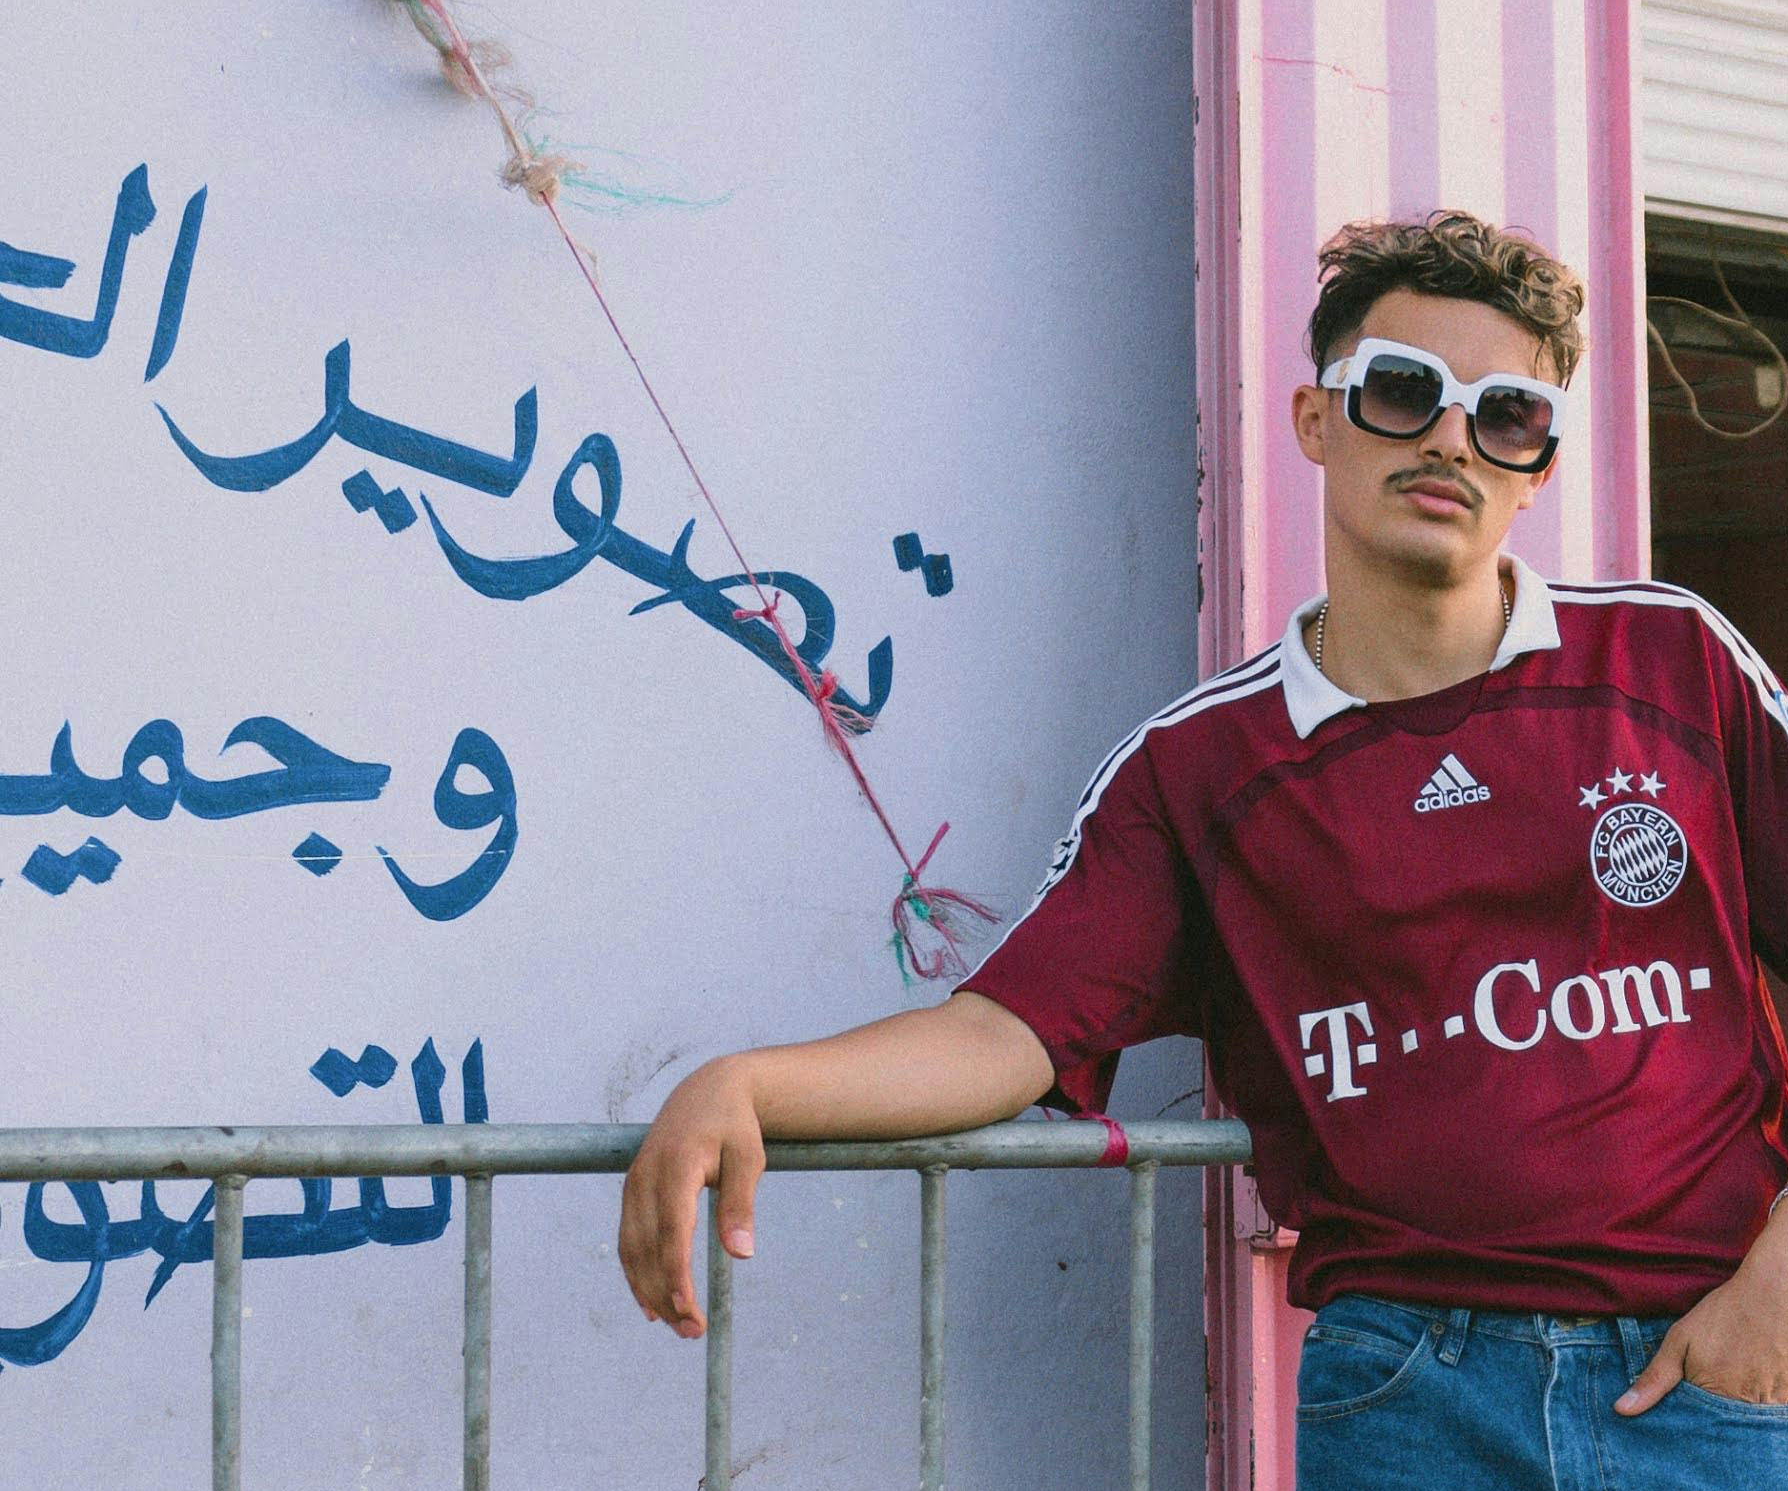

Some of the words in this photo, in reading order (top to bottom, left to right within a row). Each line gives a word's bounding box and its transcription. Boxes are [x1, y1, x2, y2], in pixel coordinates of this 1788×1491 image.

[155, 337, 955, 733] تصوير
[1414, 786, 1492, 813] adidas
[1595, 830, 1611, 858] FC
[1605, 807, 1680, 848] BAYERN
[1599, 858, 1683, 902] MÜNCHEN
